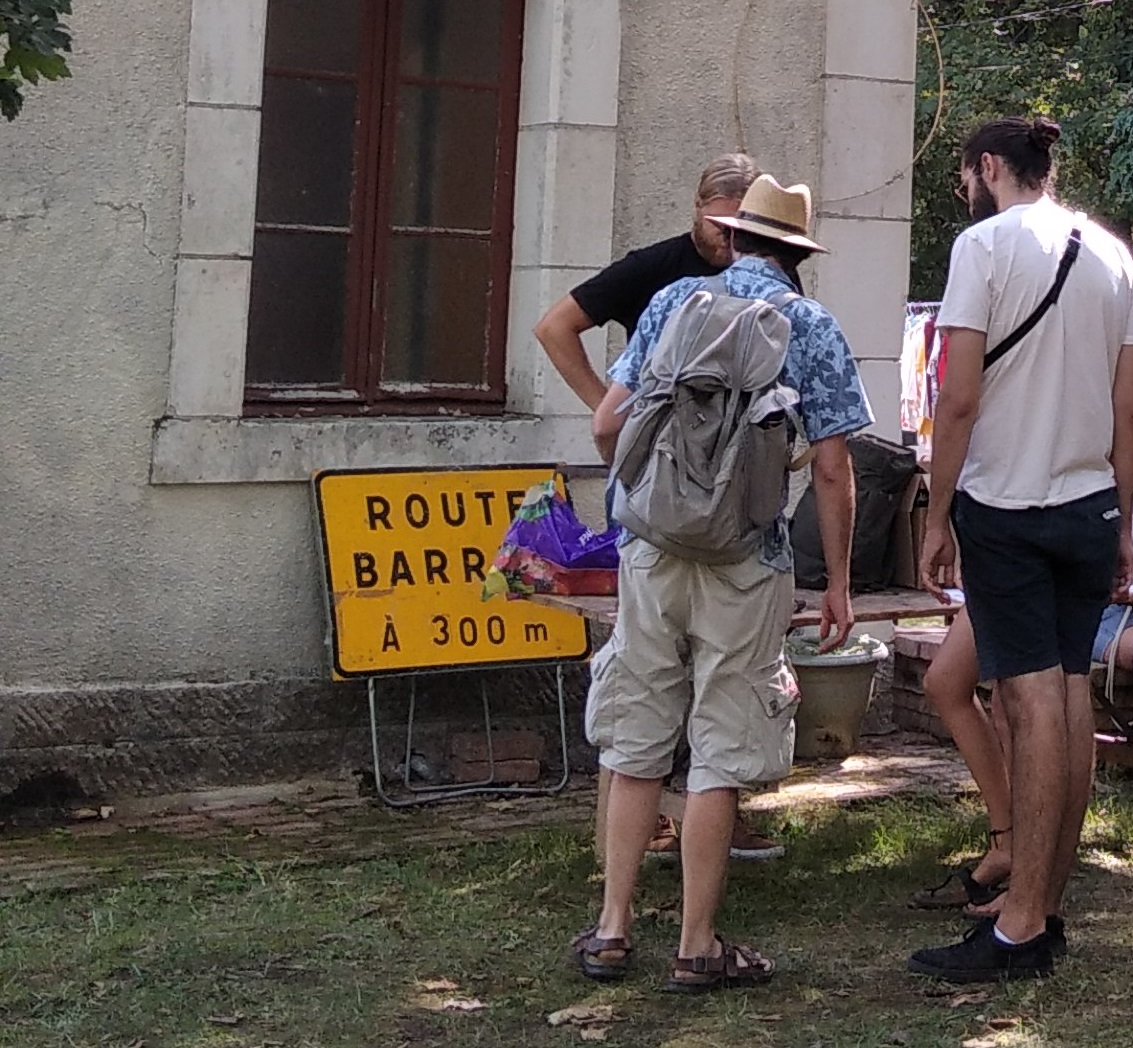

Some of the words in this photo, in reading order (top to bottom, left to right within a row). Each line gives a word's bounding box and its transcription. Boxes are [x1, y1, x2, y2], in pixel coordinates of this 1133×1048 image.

[353, 547, 487, 588] BARR
[382, 614, 401, 652] À
[432, 615, 506, 647] 300
[525, 622, 548, 642] m
